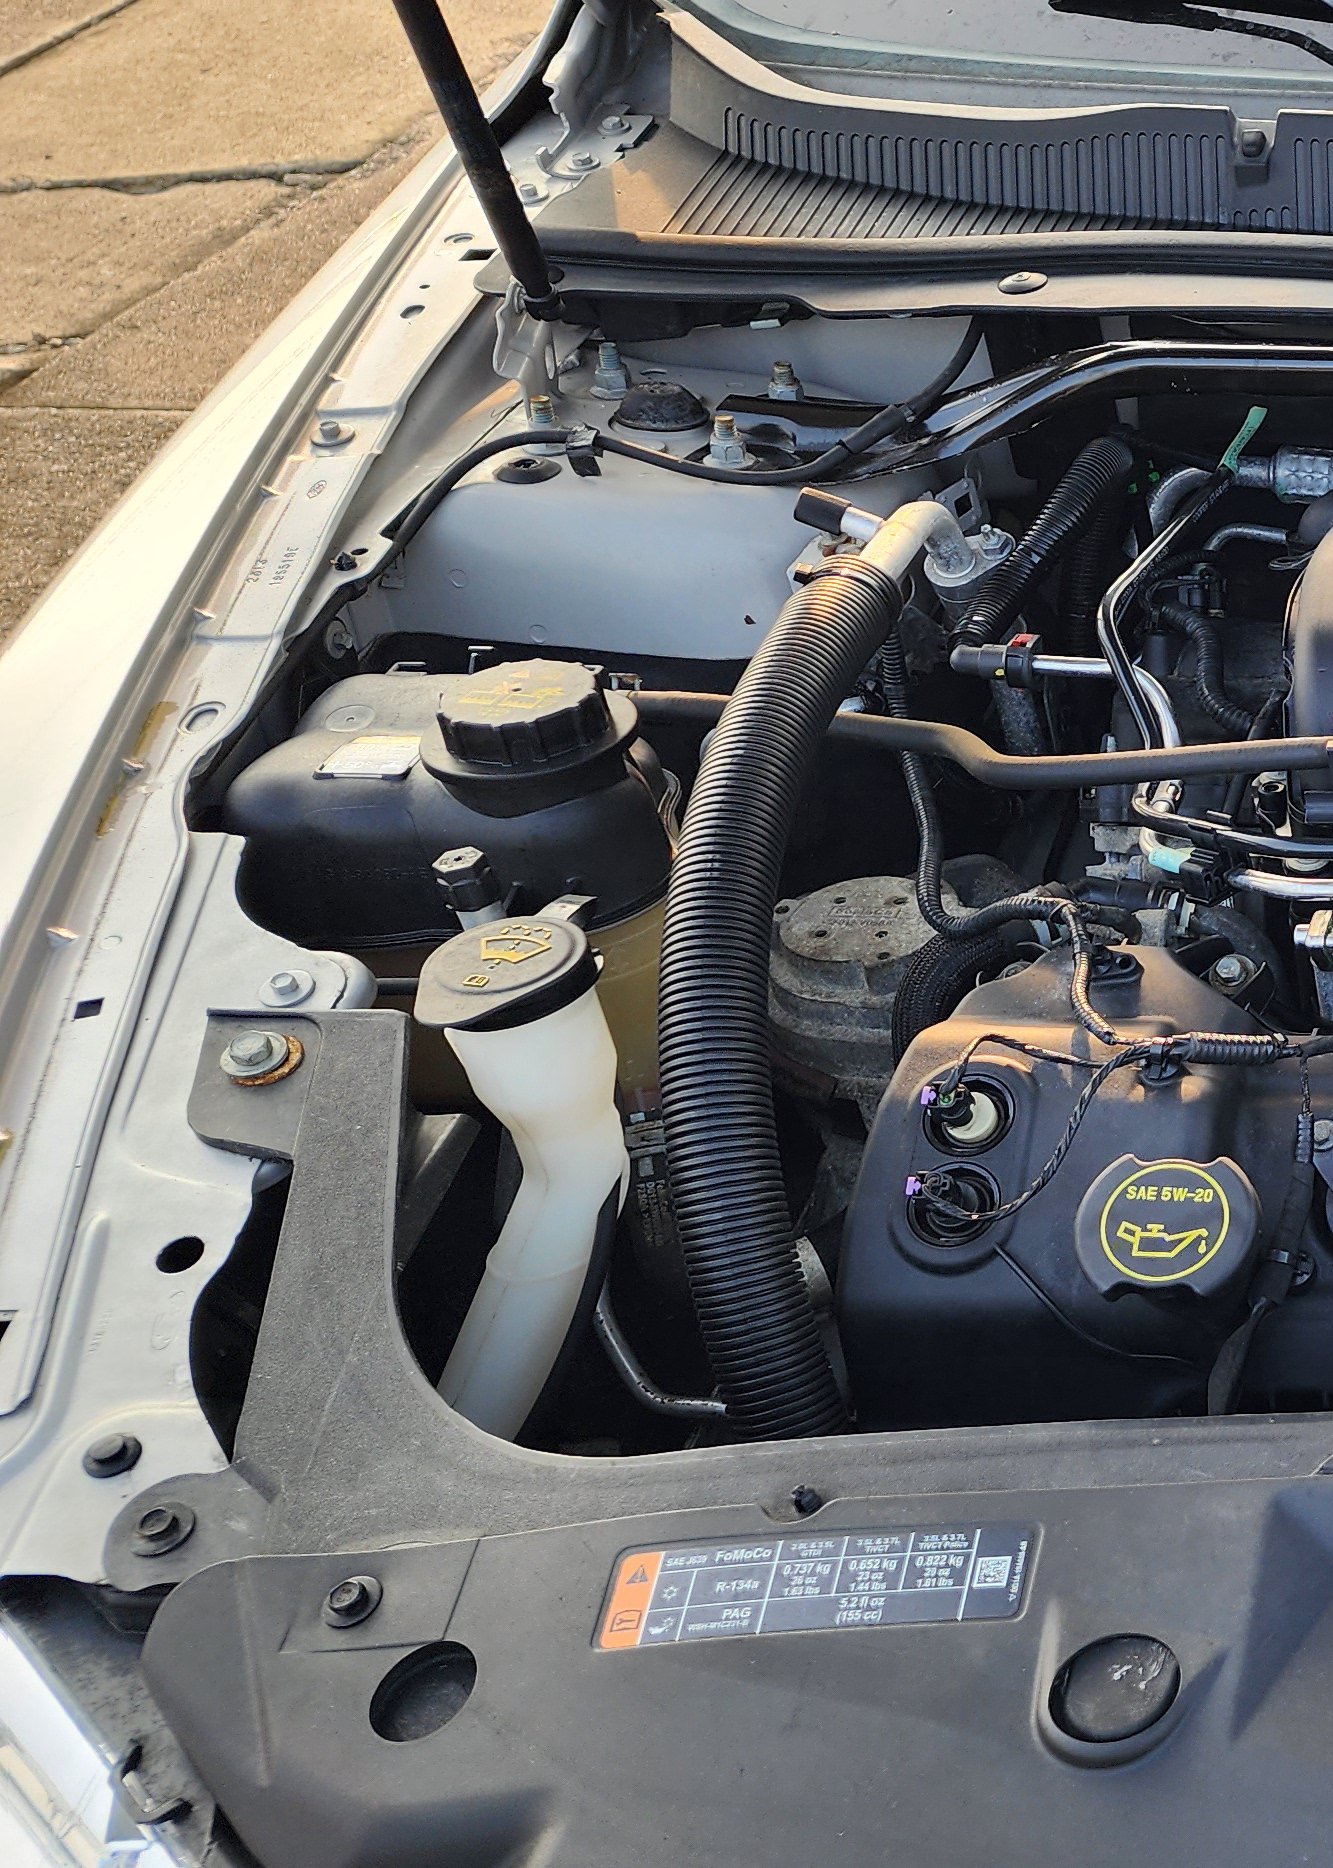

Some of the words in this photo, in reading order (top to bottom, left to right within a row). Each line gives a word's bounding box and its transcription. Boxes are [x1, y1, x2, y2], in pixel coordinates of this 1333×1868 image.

[1125, 1185, 1159, 1201] SAE
[1160, 1186, 1214, 1203] 5W-20
[665, 1557, 685, 1567] SAE
[715, 1548, 773, 1563] FoMoCo
[915, 1554, 947, 1568] 0.822
[948, 1554, 964, 1568] kg
[783, 1562, 815, 1576] 0.737
[816, 1562, 832, 1575] kg
[848, 1558, 881, 1571] 0.652
[881, 1558, 898, 1571] kg
[804, 1576, 818, 1584] oz
[857, 1571, 870, 1581] 23
[870, 1572, 884, 1580] oz
[936, 1577, 954, 1587] lbs
[715, 1579, 760, 1593] R-134a
[804, 1585, 821, 1595] lbs
[849, 1582, 869, 1592] 1.44
[870, 1581, 886, 1591] lbs
[839, 1597, 858, 1608] 5.2
[870, 1597, 886, 1607] oz
[721, 1606, 752, 1620] PAG
[835, 1609, 863, 1625] (155
[863, 1608, 883, 1623] cc)
